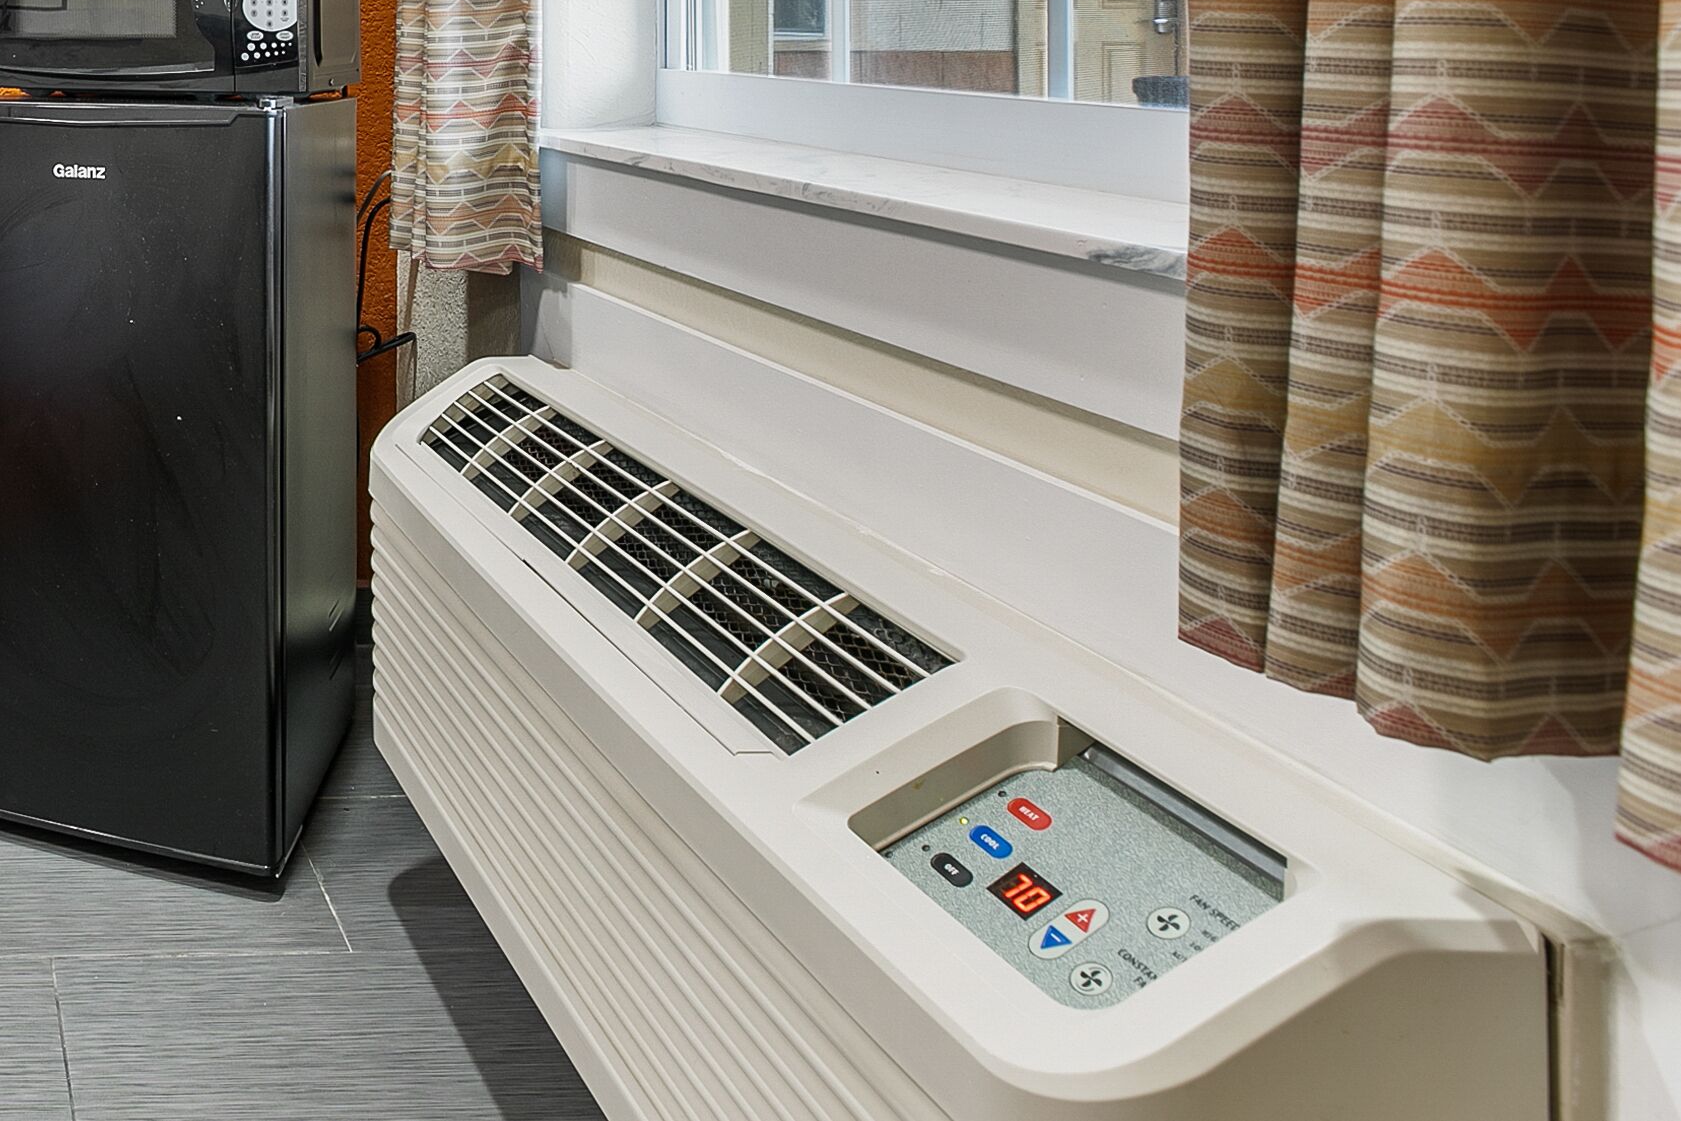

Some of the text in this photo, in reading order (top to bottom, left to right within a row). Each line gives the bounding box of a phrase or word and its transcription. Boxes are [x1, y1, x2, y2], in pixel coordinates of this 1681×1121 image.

[53, 163, 106, 180] Galanz
[1018, 806, 1040, 821] HEAT
[980, 833, 1000, 850] COOL
[943, 863, 960, 876] OFF
[1004, 872, 1052, 913] 70
[1189, 894, 1211, 911] FAN
[1133, 976, 1147, 988] FA
